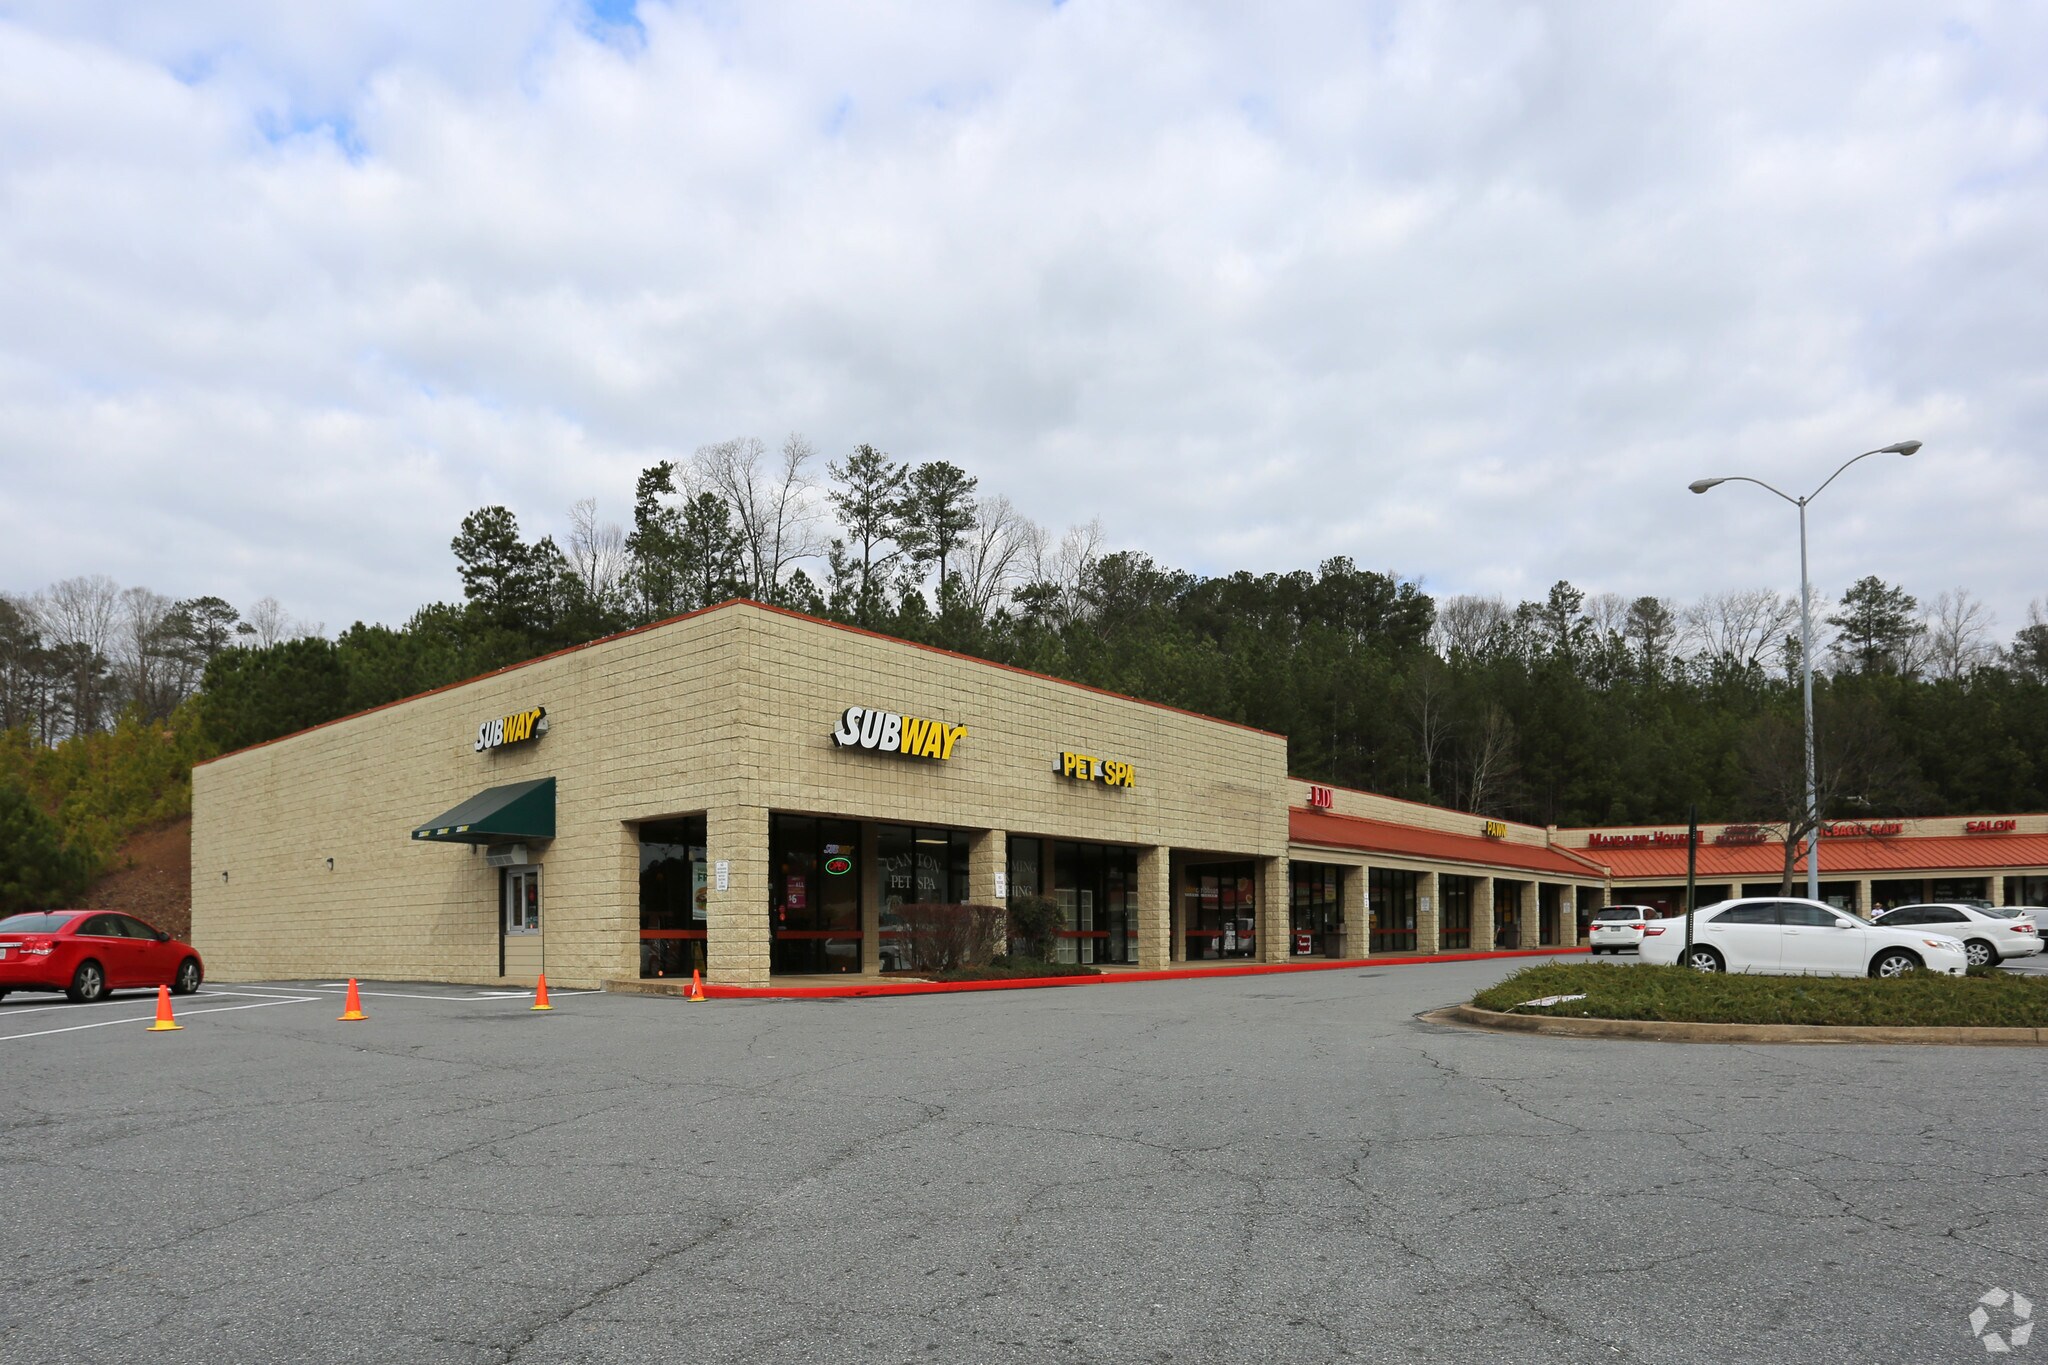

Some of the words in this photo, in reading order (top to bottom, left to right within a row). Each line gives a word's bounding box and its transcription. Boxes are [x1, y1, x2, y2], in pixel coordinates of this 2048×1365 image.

[474, 706, 544, 750] SUBWAY
[834, 706, 968, 760] SUBWAY
[1061, 751, 1099, 781] PET
[1102, 759, 1136, 788] SPA
[1486, 821, 1508, 839] PAWN
[1966, 820, 2017, 833] SALON
[1589, 833, 1650, 846] MANDARIN
[828, 861, 848, 872] OPEN
[886, 852, 941, 875] CANTON
[890, 875, 912, 889] PET
[917, 876, 937, 890] SPA
